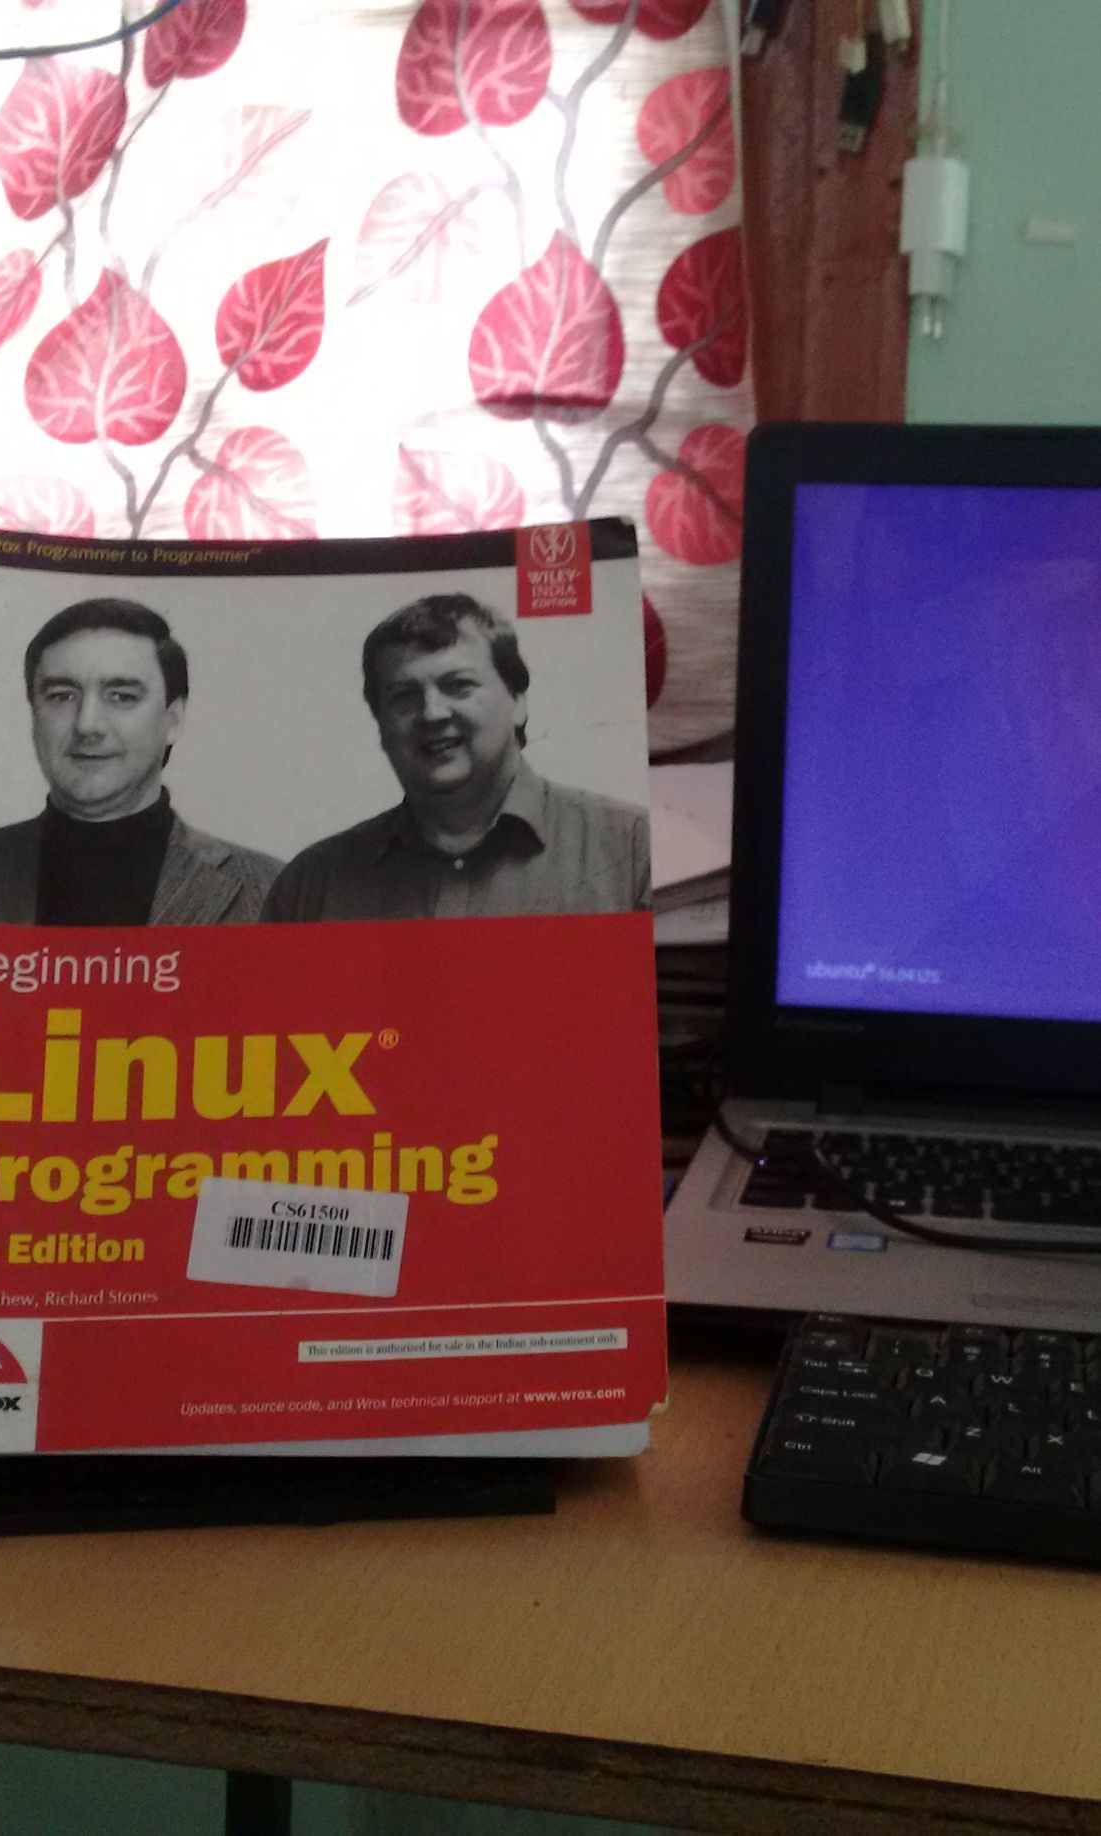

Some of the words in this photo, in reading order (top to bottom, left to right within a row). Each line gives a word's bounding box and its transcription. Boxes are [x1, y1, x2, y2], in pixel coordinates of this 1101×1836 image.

[27, 540, 125, 561] Programmer
[131, 550, 147, 562] to
[531, 583, 576, 598] INDIA
[271, 1200, 349, 1222] CS61500
[8, 1232, 145, 1264] Edition
[45, 1289, 104, 1306] Richard
[109, 1288, 159, 1304] Stones
[308, 1345, 326, 1356] This
[330, 1343, 363, 1355] edition
[366, 1344, 375, 1355] is
[377, 1341, 426, 1355] authorized
[429, 1340, 441, 1352] for
[444, 1340, 462, 1351] sale
[465, 1339, 475, 1350] in
[478, 1339, 493, 1350] the
[496, 1337, 527, 1349] Indian
[598, 1332, 618, 1346] only
[991, 1373, 1014, 1385] W
[799, 1385, 839, 1398] Caps
[180, 1403, 237, 1417] Updates,
[240, 1402, 286, 1413] source
[288, 1399, 323, 1413] code,
[327, 1399, 353, 1411] and
[356, 1397, 387, 1410] Wrox
[391, 1394, 449, 1409] technical
[453, 1393, 504, 1408] support
[506, 1392, 521, 1403] at
[523, 1386, 626, 1403] www.wrox.com
[784, 1440, 813, 1451] Ctrl
[1048, 1433, 1065, 1446] X
